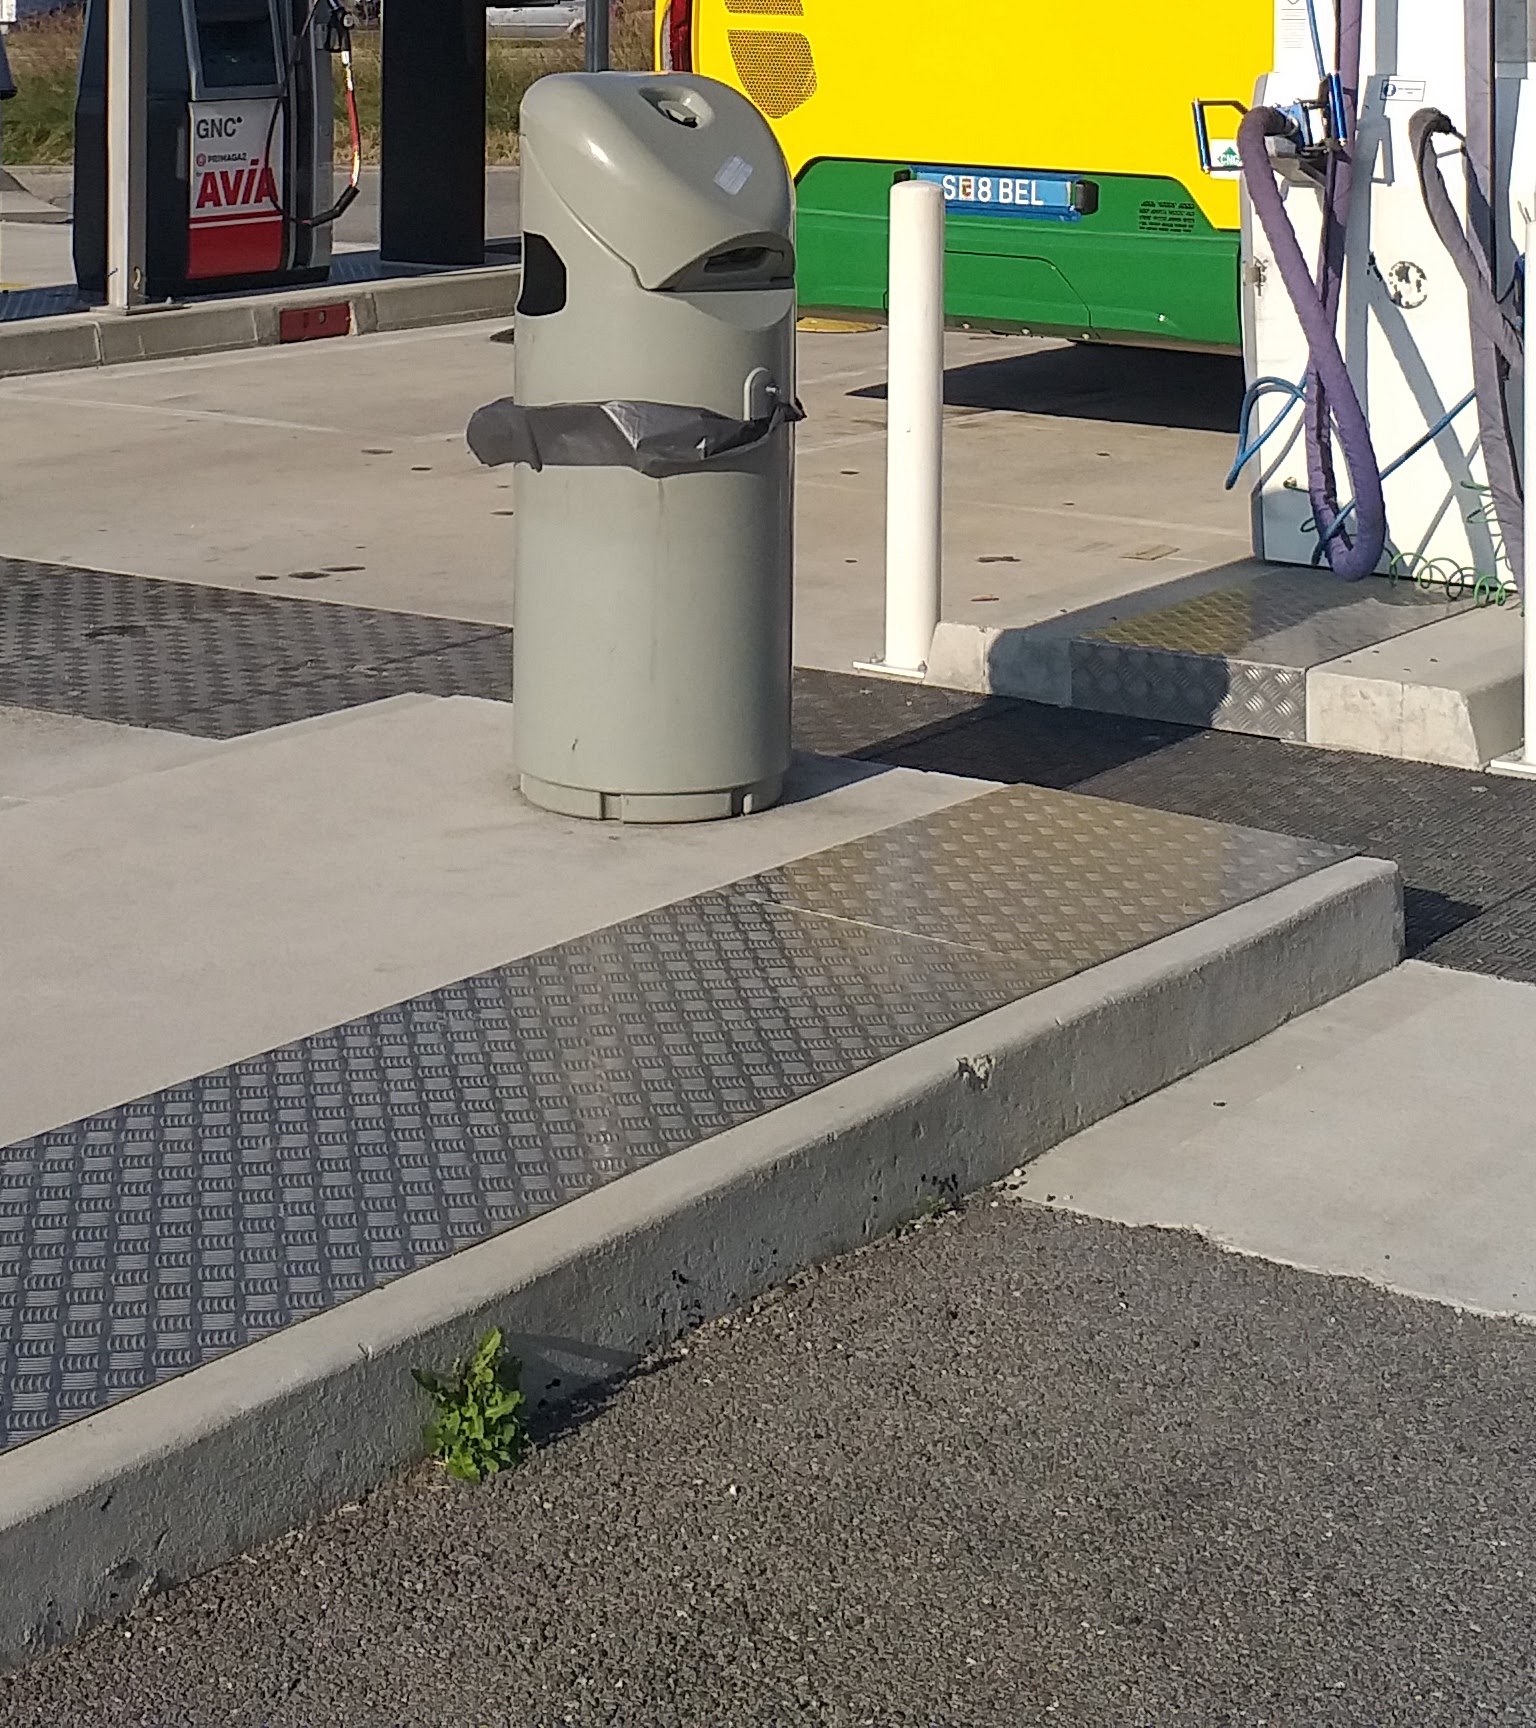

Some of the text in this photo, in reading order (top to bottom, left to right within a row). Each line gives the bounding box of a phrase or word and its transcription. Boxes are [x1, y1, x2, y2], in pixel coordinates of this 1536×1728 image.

[196, 117, 237, 140] GNC
[195, 158, 279, 209] AVIA
[998, 178, 1044, 206] BEL
